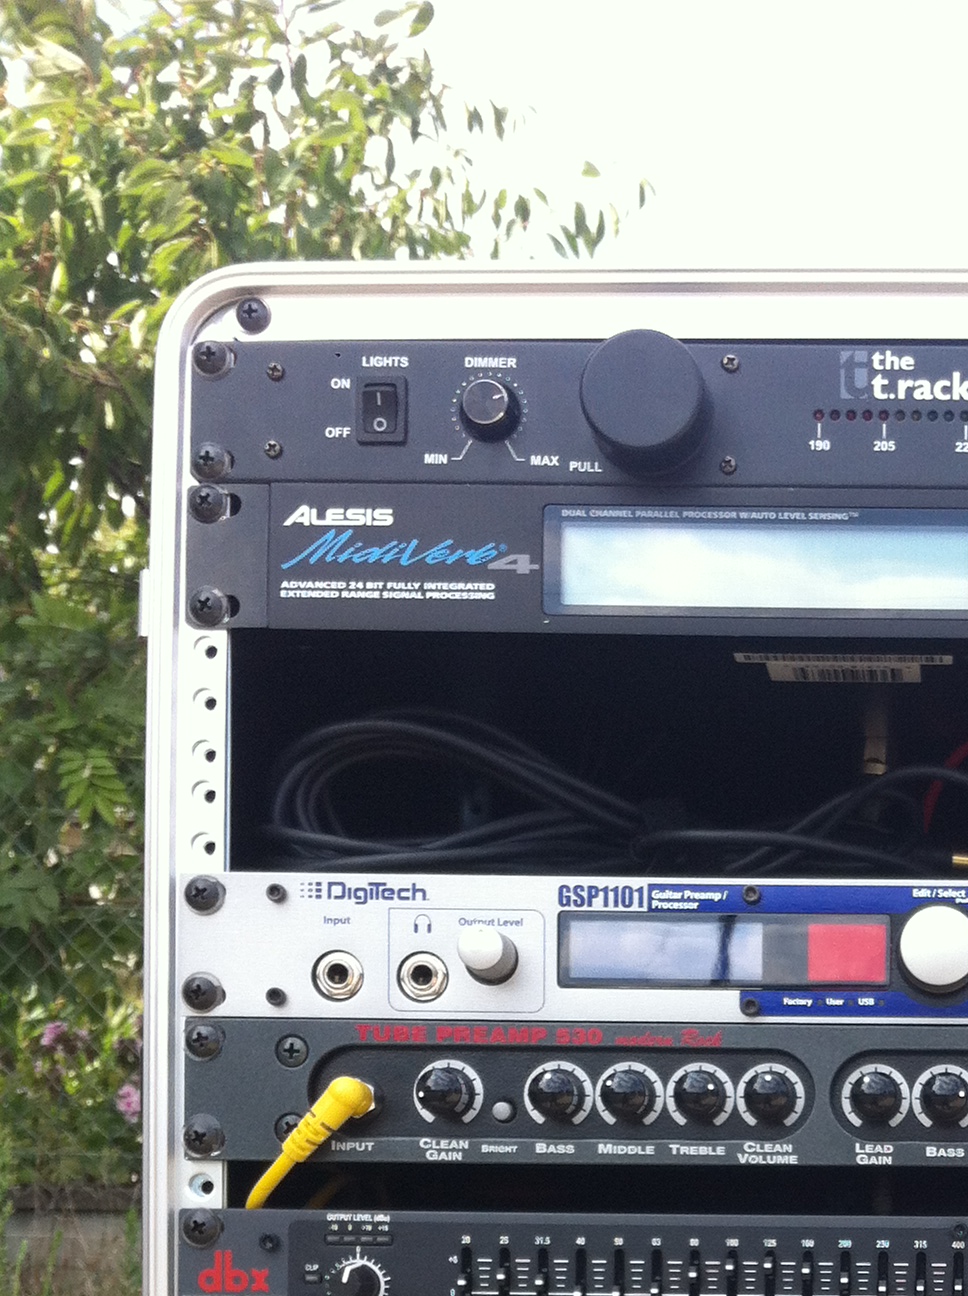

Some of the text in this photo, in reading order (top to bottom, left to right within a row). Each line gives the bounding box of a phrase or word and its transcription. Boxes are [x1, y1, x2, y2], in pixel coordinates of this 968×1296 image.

[362, 356, 409, 368] LIGHTS
[464, 357, 517, 369] DIMMER
[871, 351, 915, 371] the
[331, 378, 350, 389] ON
[325, 427, 351, 438] OFF
[809, 440, 830, 451] 190
[873, 441, 896, 452] 205
[424, 454, 448, 465] MIN
[530, 455, 559, 466] MAX
[569, 461, 602, 472] PULL
[283, 504, 394, 526] ALESIS
[561, 509, 586, 517] DUAL
[590, 509, 633, 518] CHANNEL
[635, 510, 680, 519] PARALLEL
[683, 511, 737, 519] PROCESSOR
[778, 512, 807, 520] LEVEL
[487, 554, 540, 574] 4
[280, 581, 495, 591] ADVANCED 24 BIT FULLY INTEGRATED
[280, 590, 495, 600] EXTENDED RANGE SIGNAL PROCESSING
[327, 881, 428, 904] DigiTech
[558, 885, 645, 908] GSP1101
[651, 890, 722, 901] Guitar Preamp
[912, 889, 966, 898] Edit Select
[651, 900, 699, 910] Processor
[323, 916, 351, 926] Input
[498, 917, 524, 927] Level
[783, 998, 813, 1008] Factory
[858, 998, 875, 1006] USB
[355, 1024, 603, 1045] TUBE PREAMP 530
[331, 1140, 374, 1151] INPUT
[419, 1138, 469, 1150] CLEAN
[481, 1145, 518, 1153] BRIGHT
[535, 1143, 575, 1154] BASS
[598, 1143, 655, 1155] MIDDLE
[669, 1144, 725, 1155] TREBLE
[743, 1142, 793, 1153] CLEAN
[855, 1143, 893, 1153] LEAD
[426, 1150, 462, 1161] GAIN
[926, 1146, 965, 1157] BASS
[737, 1153, 798, 1164] VOLUME
[856, 1154, 892, 1165] GAIN
[327, 1213, 352, 1221] OUTPUT
[197, 1250, 269, 1293] dbx
